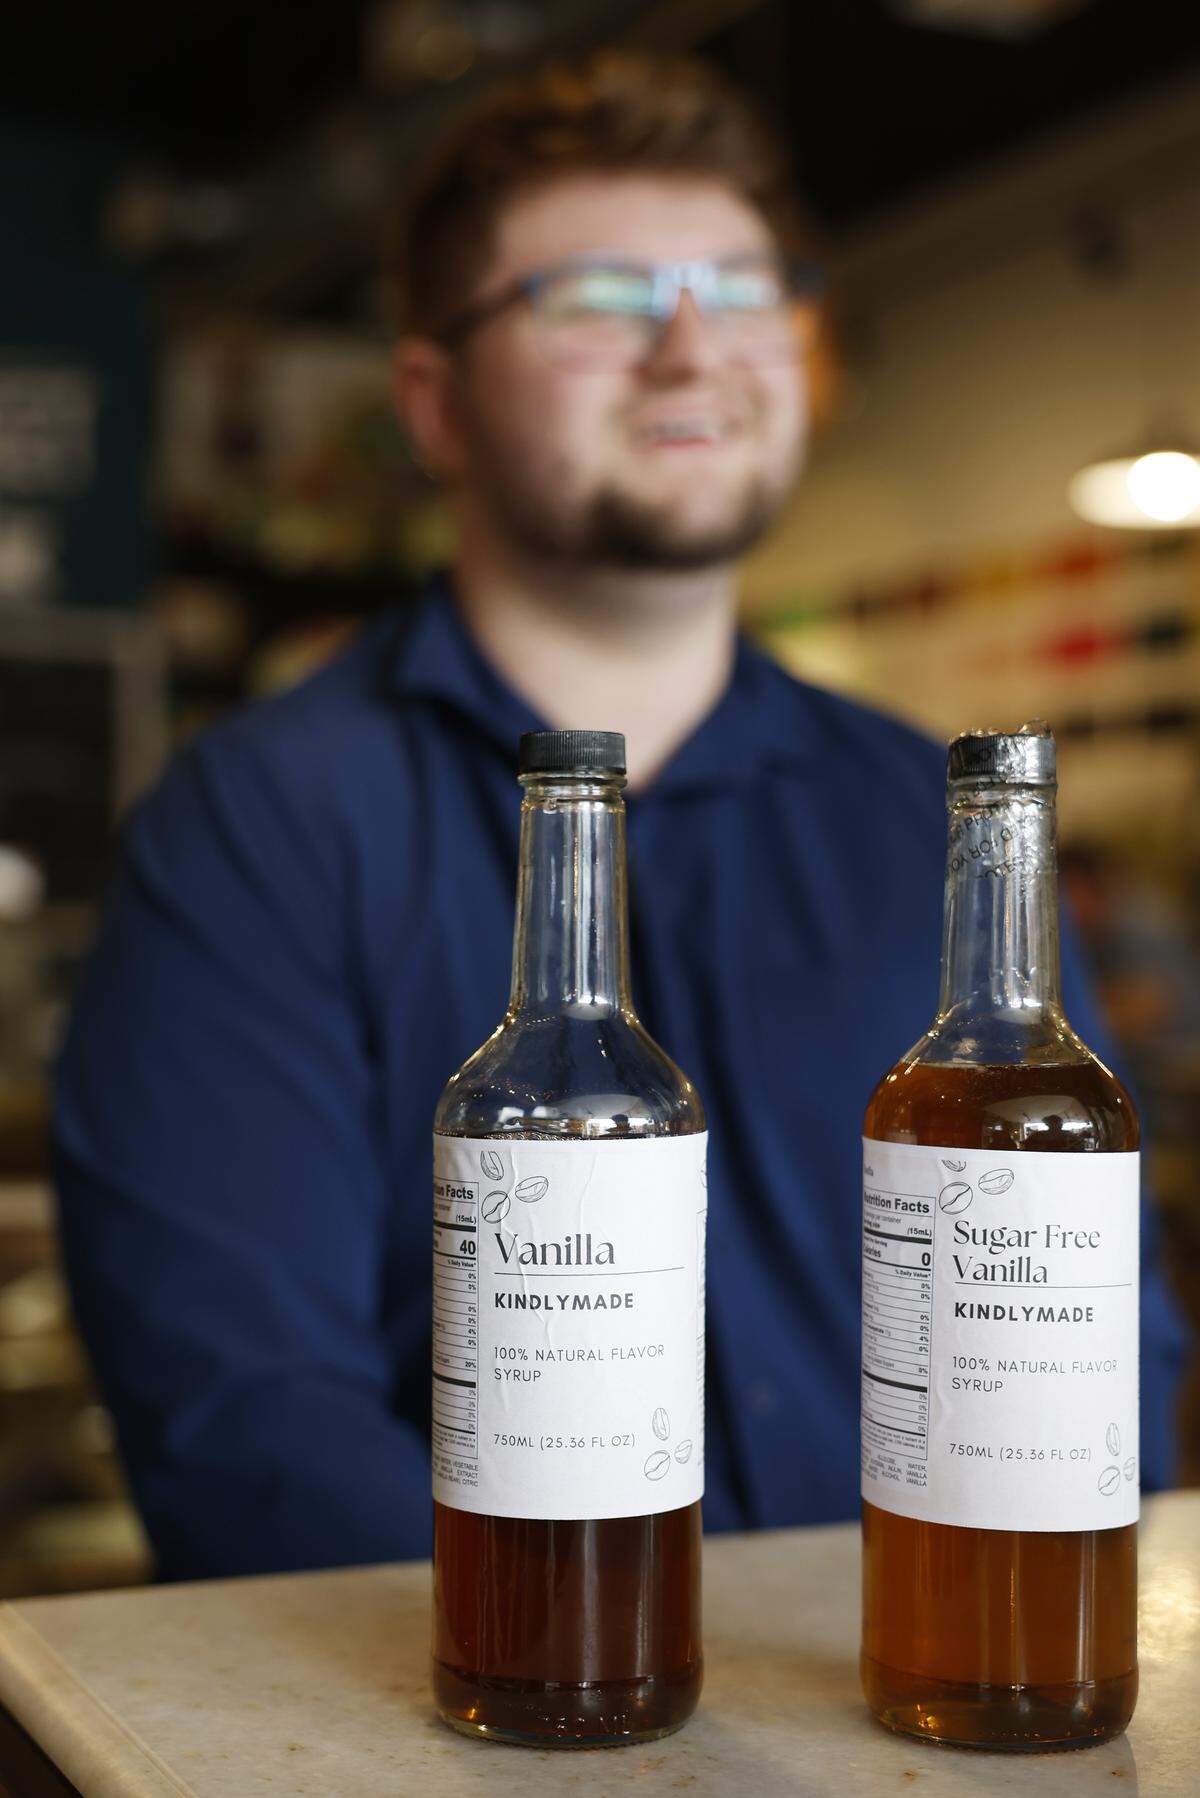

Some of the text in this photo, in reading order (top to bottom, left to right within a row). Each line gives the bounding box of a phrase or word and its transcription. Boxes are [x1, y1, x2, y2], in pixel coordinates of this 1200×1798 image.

[446, 1184, 474, 1200] Facts
[894, 1198, 930, 1214] Facts
[456, 1214, 477, 1225] (15mL)
[907, 1227, 932, 1238] (15mL)
[952, 1218, 1101, 1255] Sugar Free
[459, 1239, 476, 1255] 40
[493, 1231, 616, 1267] Vanilla
[922, 1252, 931, 1266] 0
[952, 1253, 1048, 1284] Vanilla
[493, 1291, 634, 1312] KINDLYMADE
[953, 1301, 1094, 1323] KINDLYMADE
[493, 1344, 665, 1362] 100% NATURAL FLAVOR
[952, 1355, 990, 1372] 100%
[996, 1359, 1065, 1374] NATURAL
[493, 1368, 542, 1383] SYRUP
[952, 1377, 1004, 1393] SYRUP
[493, 1433, 535, 1448] 750ML
[540, 1435, 586, 1451] (25.36
[591, 1437, 606, 1448] FL
[611, 1433, 636, 1448] OZ)
[949, 1442, 1092, 1463] 750ML (25.36 FL OZ)
[456, 1469, 478, 1480] EXTRACT
